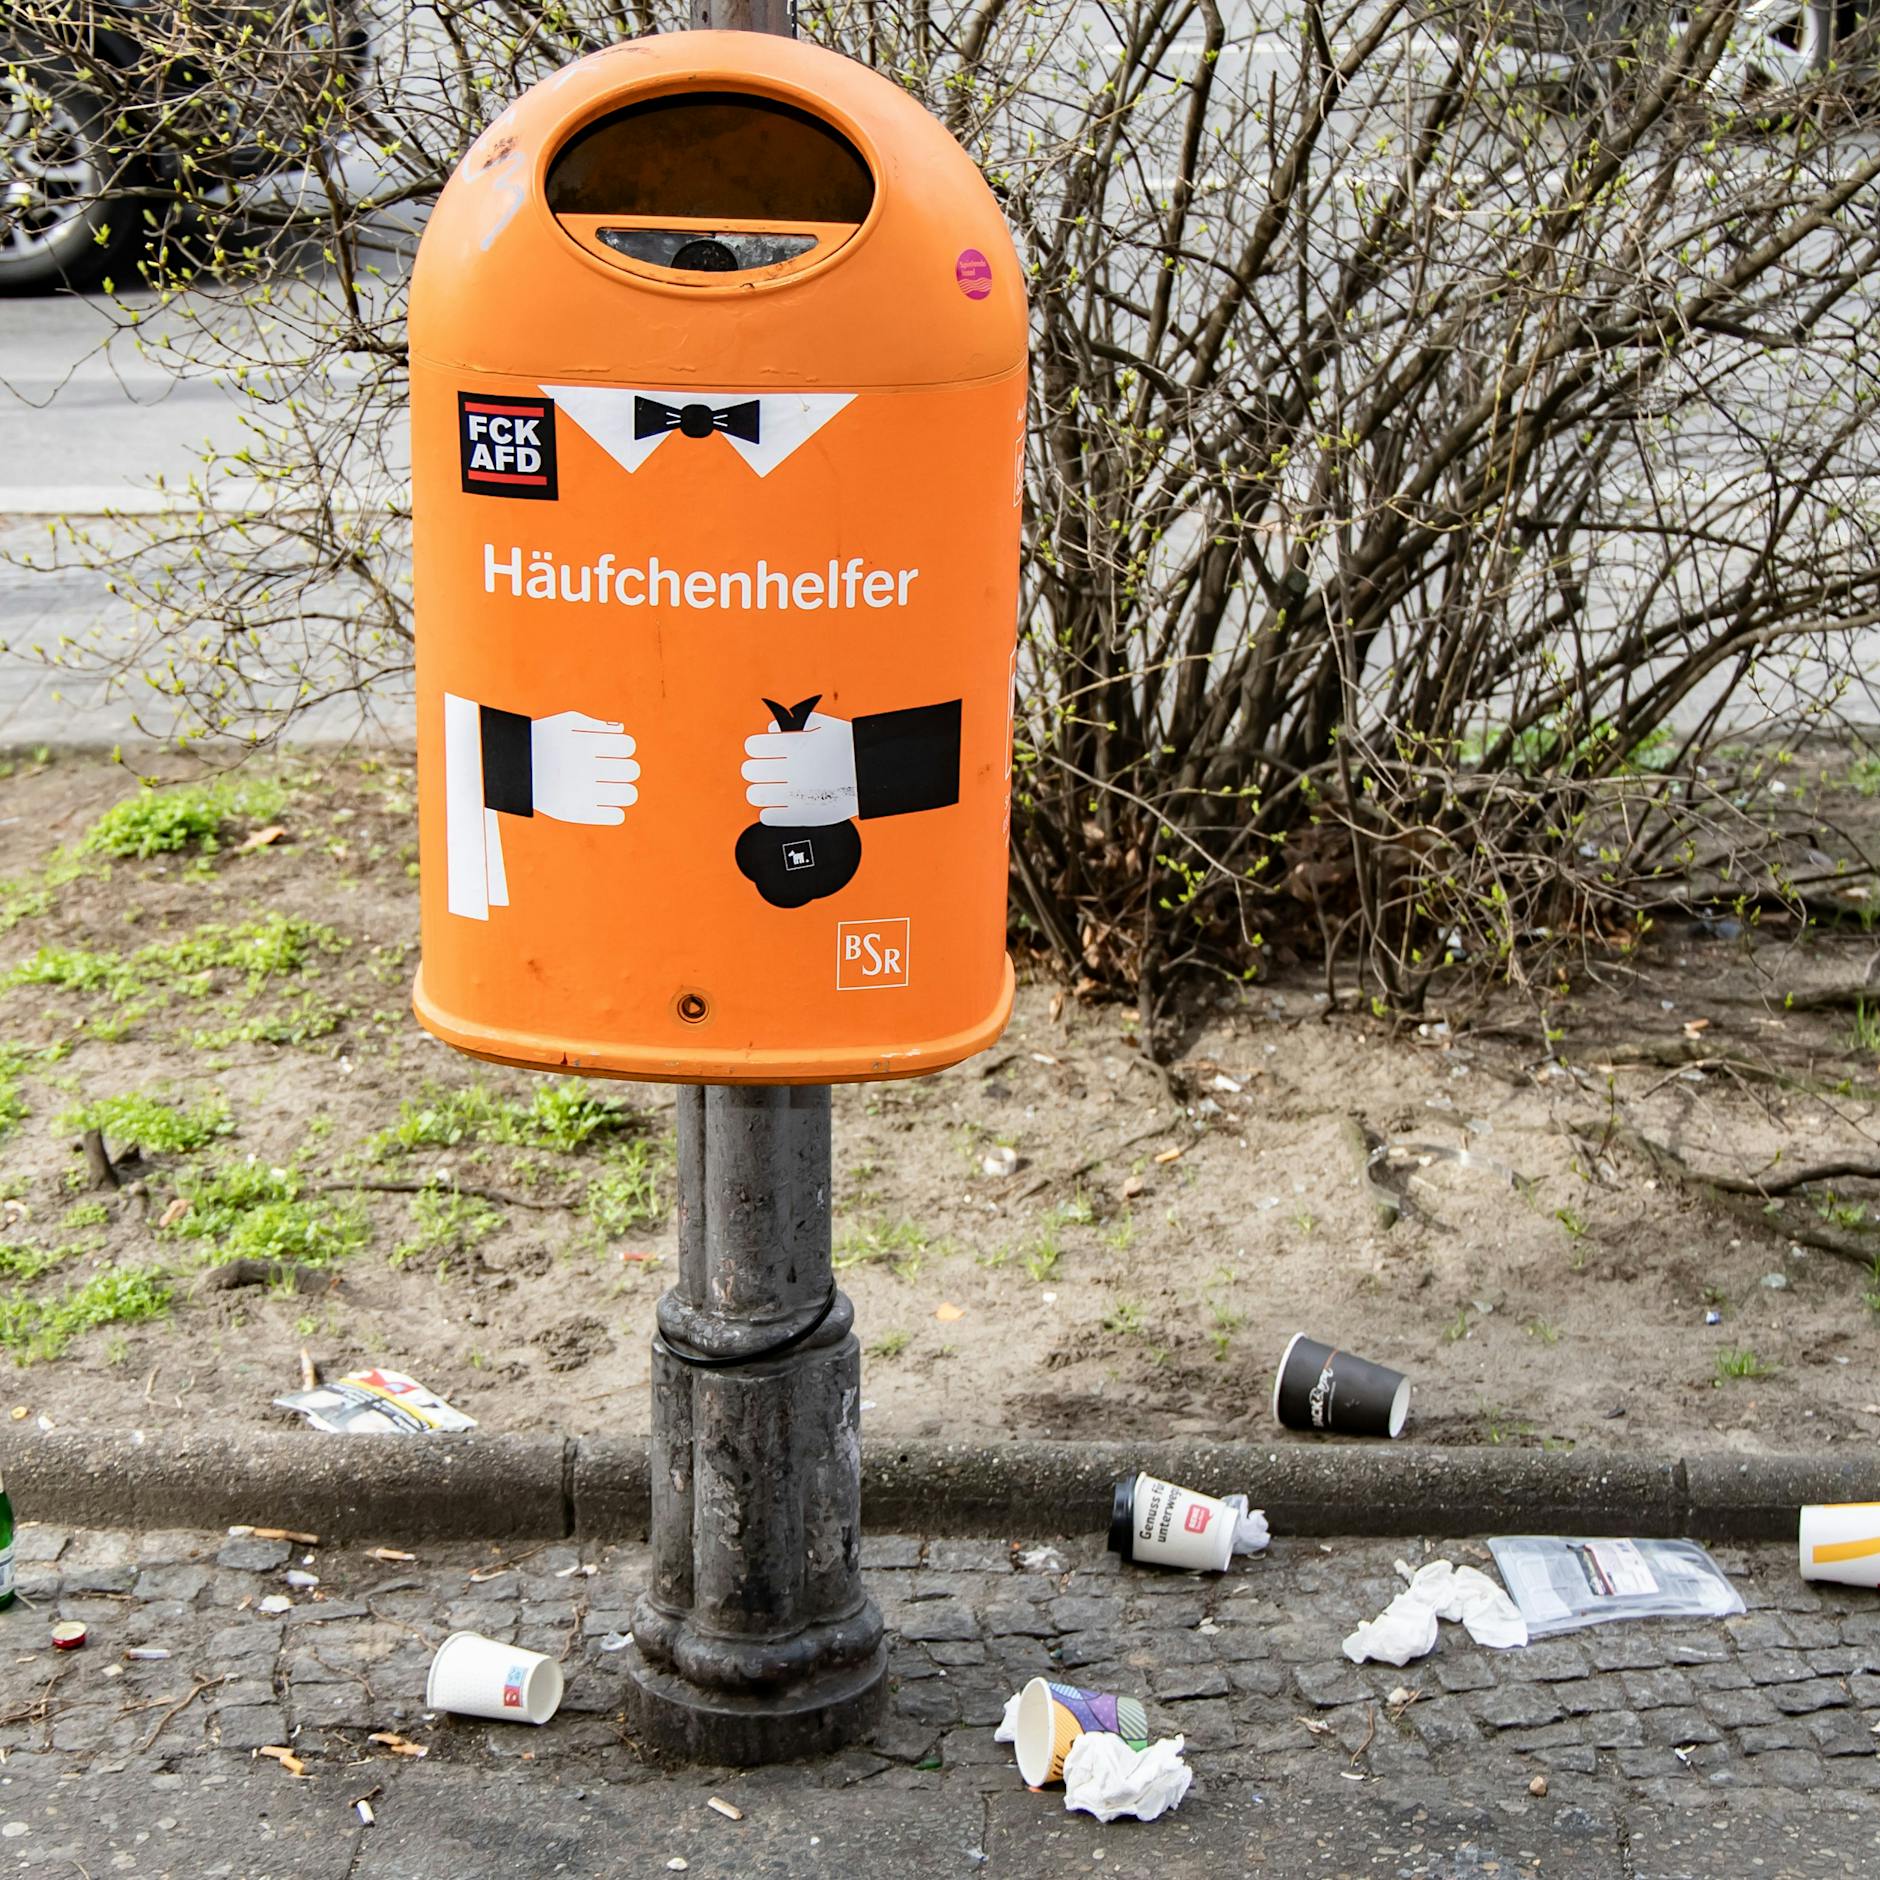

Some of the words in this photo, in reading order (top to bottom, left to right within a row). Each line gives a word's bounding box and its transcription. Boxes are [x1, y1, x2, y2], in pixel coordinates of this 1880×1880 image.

[468, 414, 541, 446] FCK
[470, 443, 541, 473] AFD
[484, 543, 919, 610] Häufchenhelfer
[845, 933, 902, 976] BSR
[1139, 1496, 1160, 1540] Genuss
